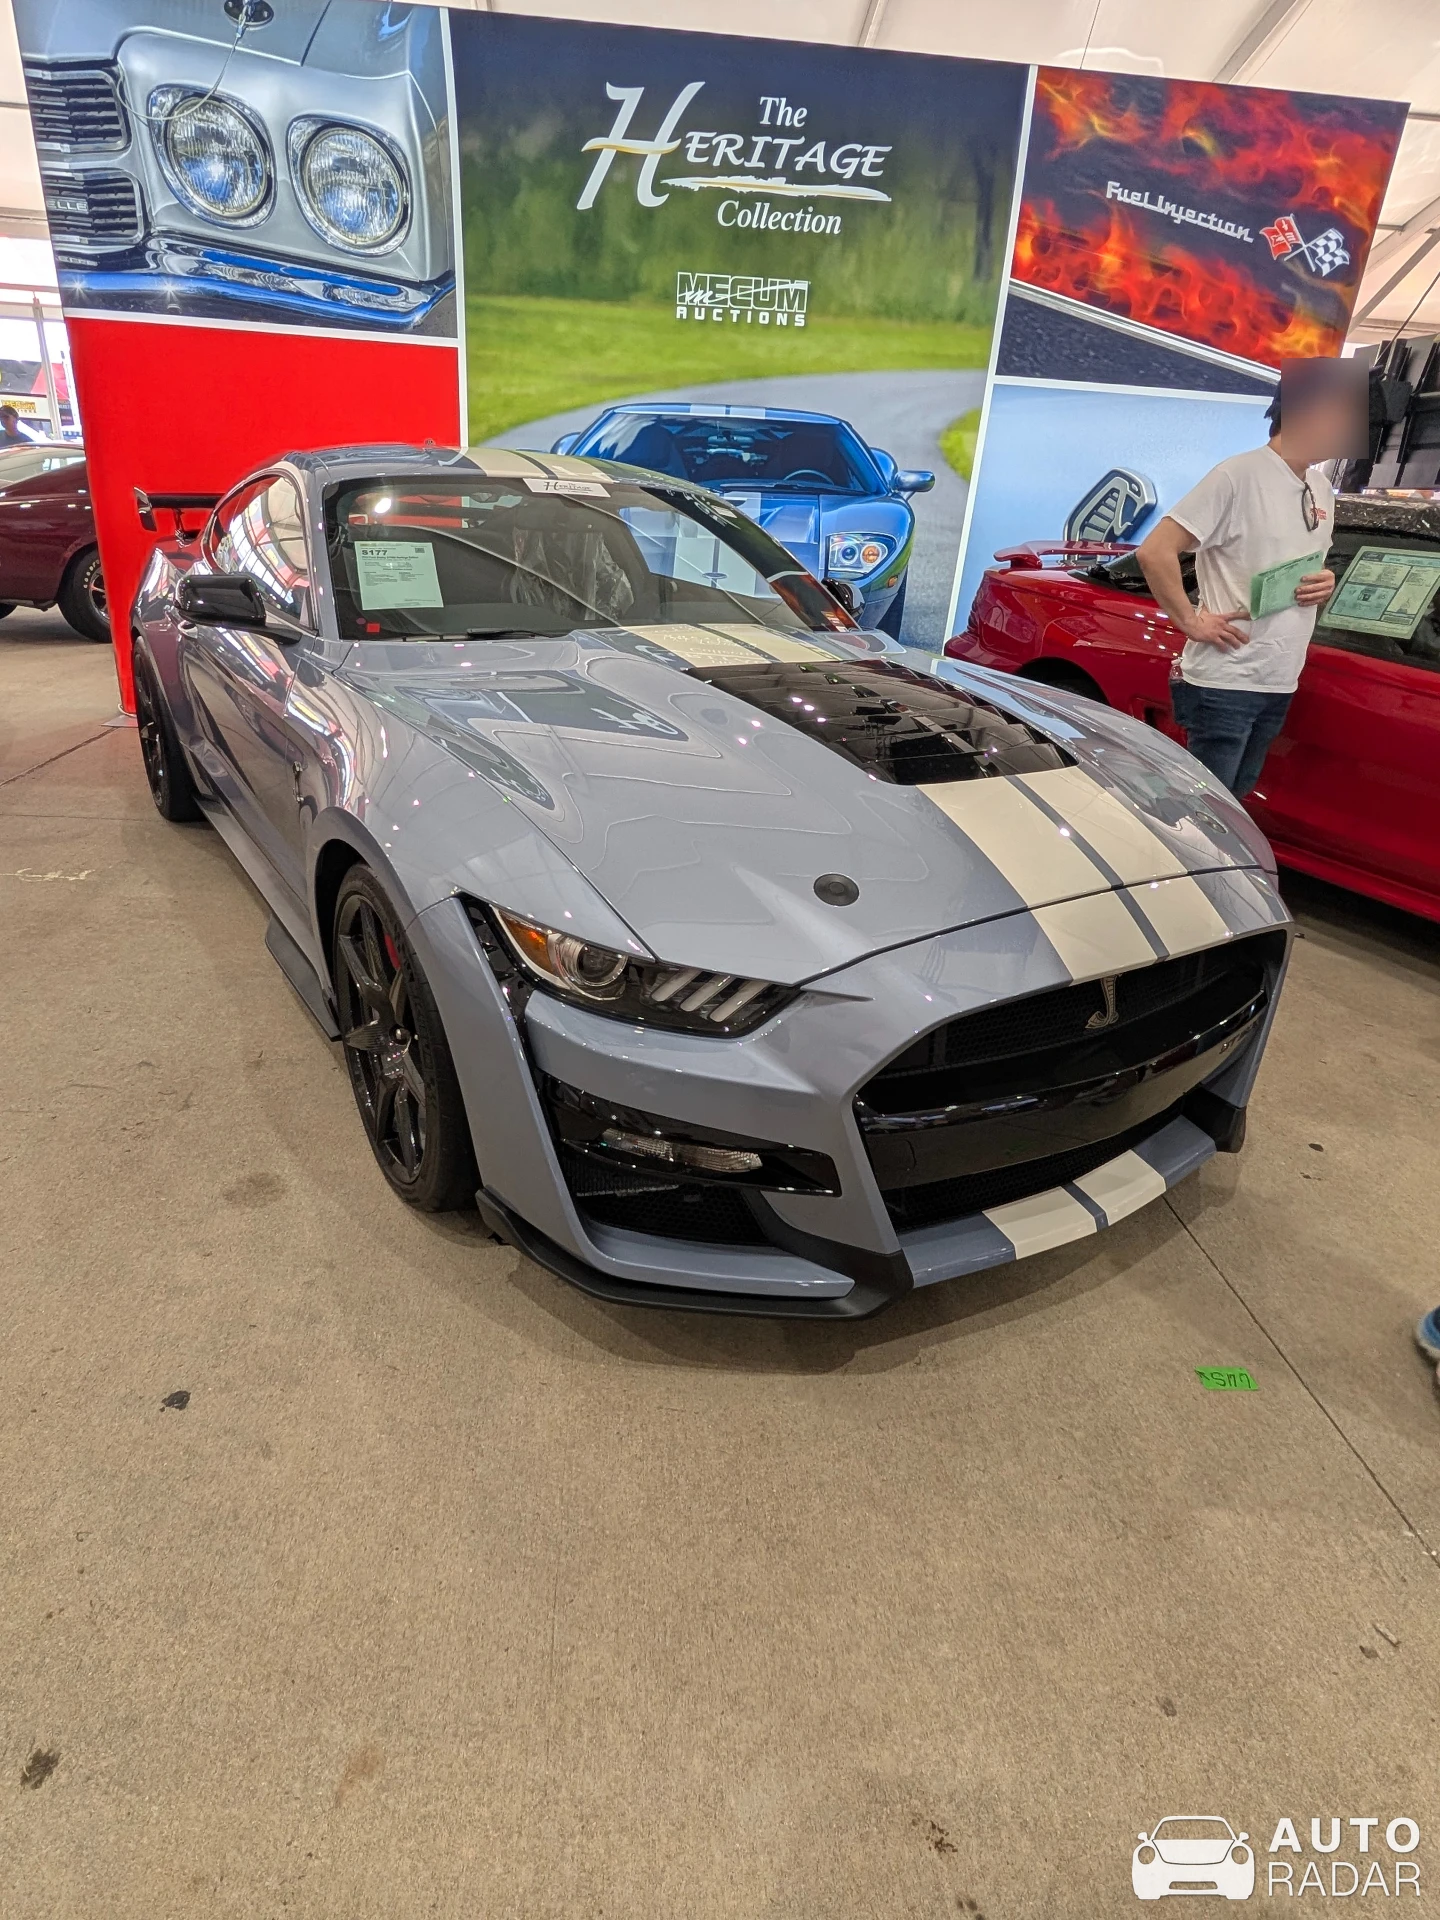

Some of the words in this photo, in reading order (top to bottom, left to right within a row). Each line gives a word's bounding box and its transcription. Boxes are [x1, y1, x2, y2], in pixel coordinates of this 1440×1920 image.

[759, 96, 808, 128] The
[577, 81, 893, 210] HERITAGE
[717, 200, 842, 234] Collection
[677, 272, 809, 313] MECUM
[676, 306, 805, 327] AUCTIONS
